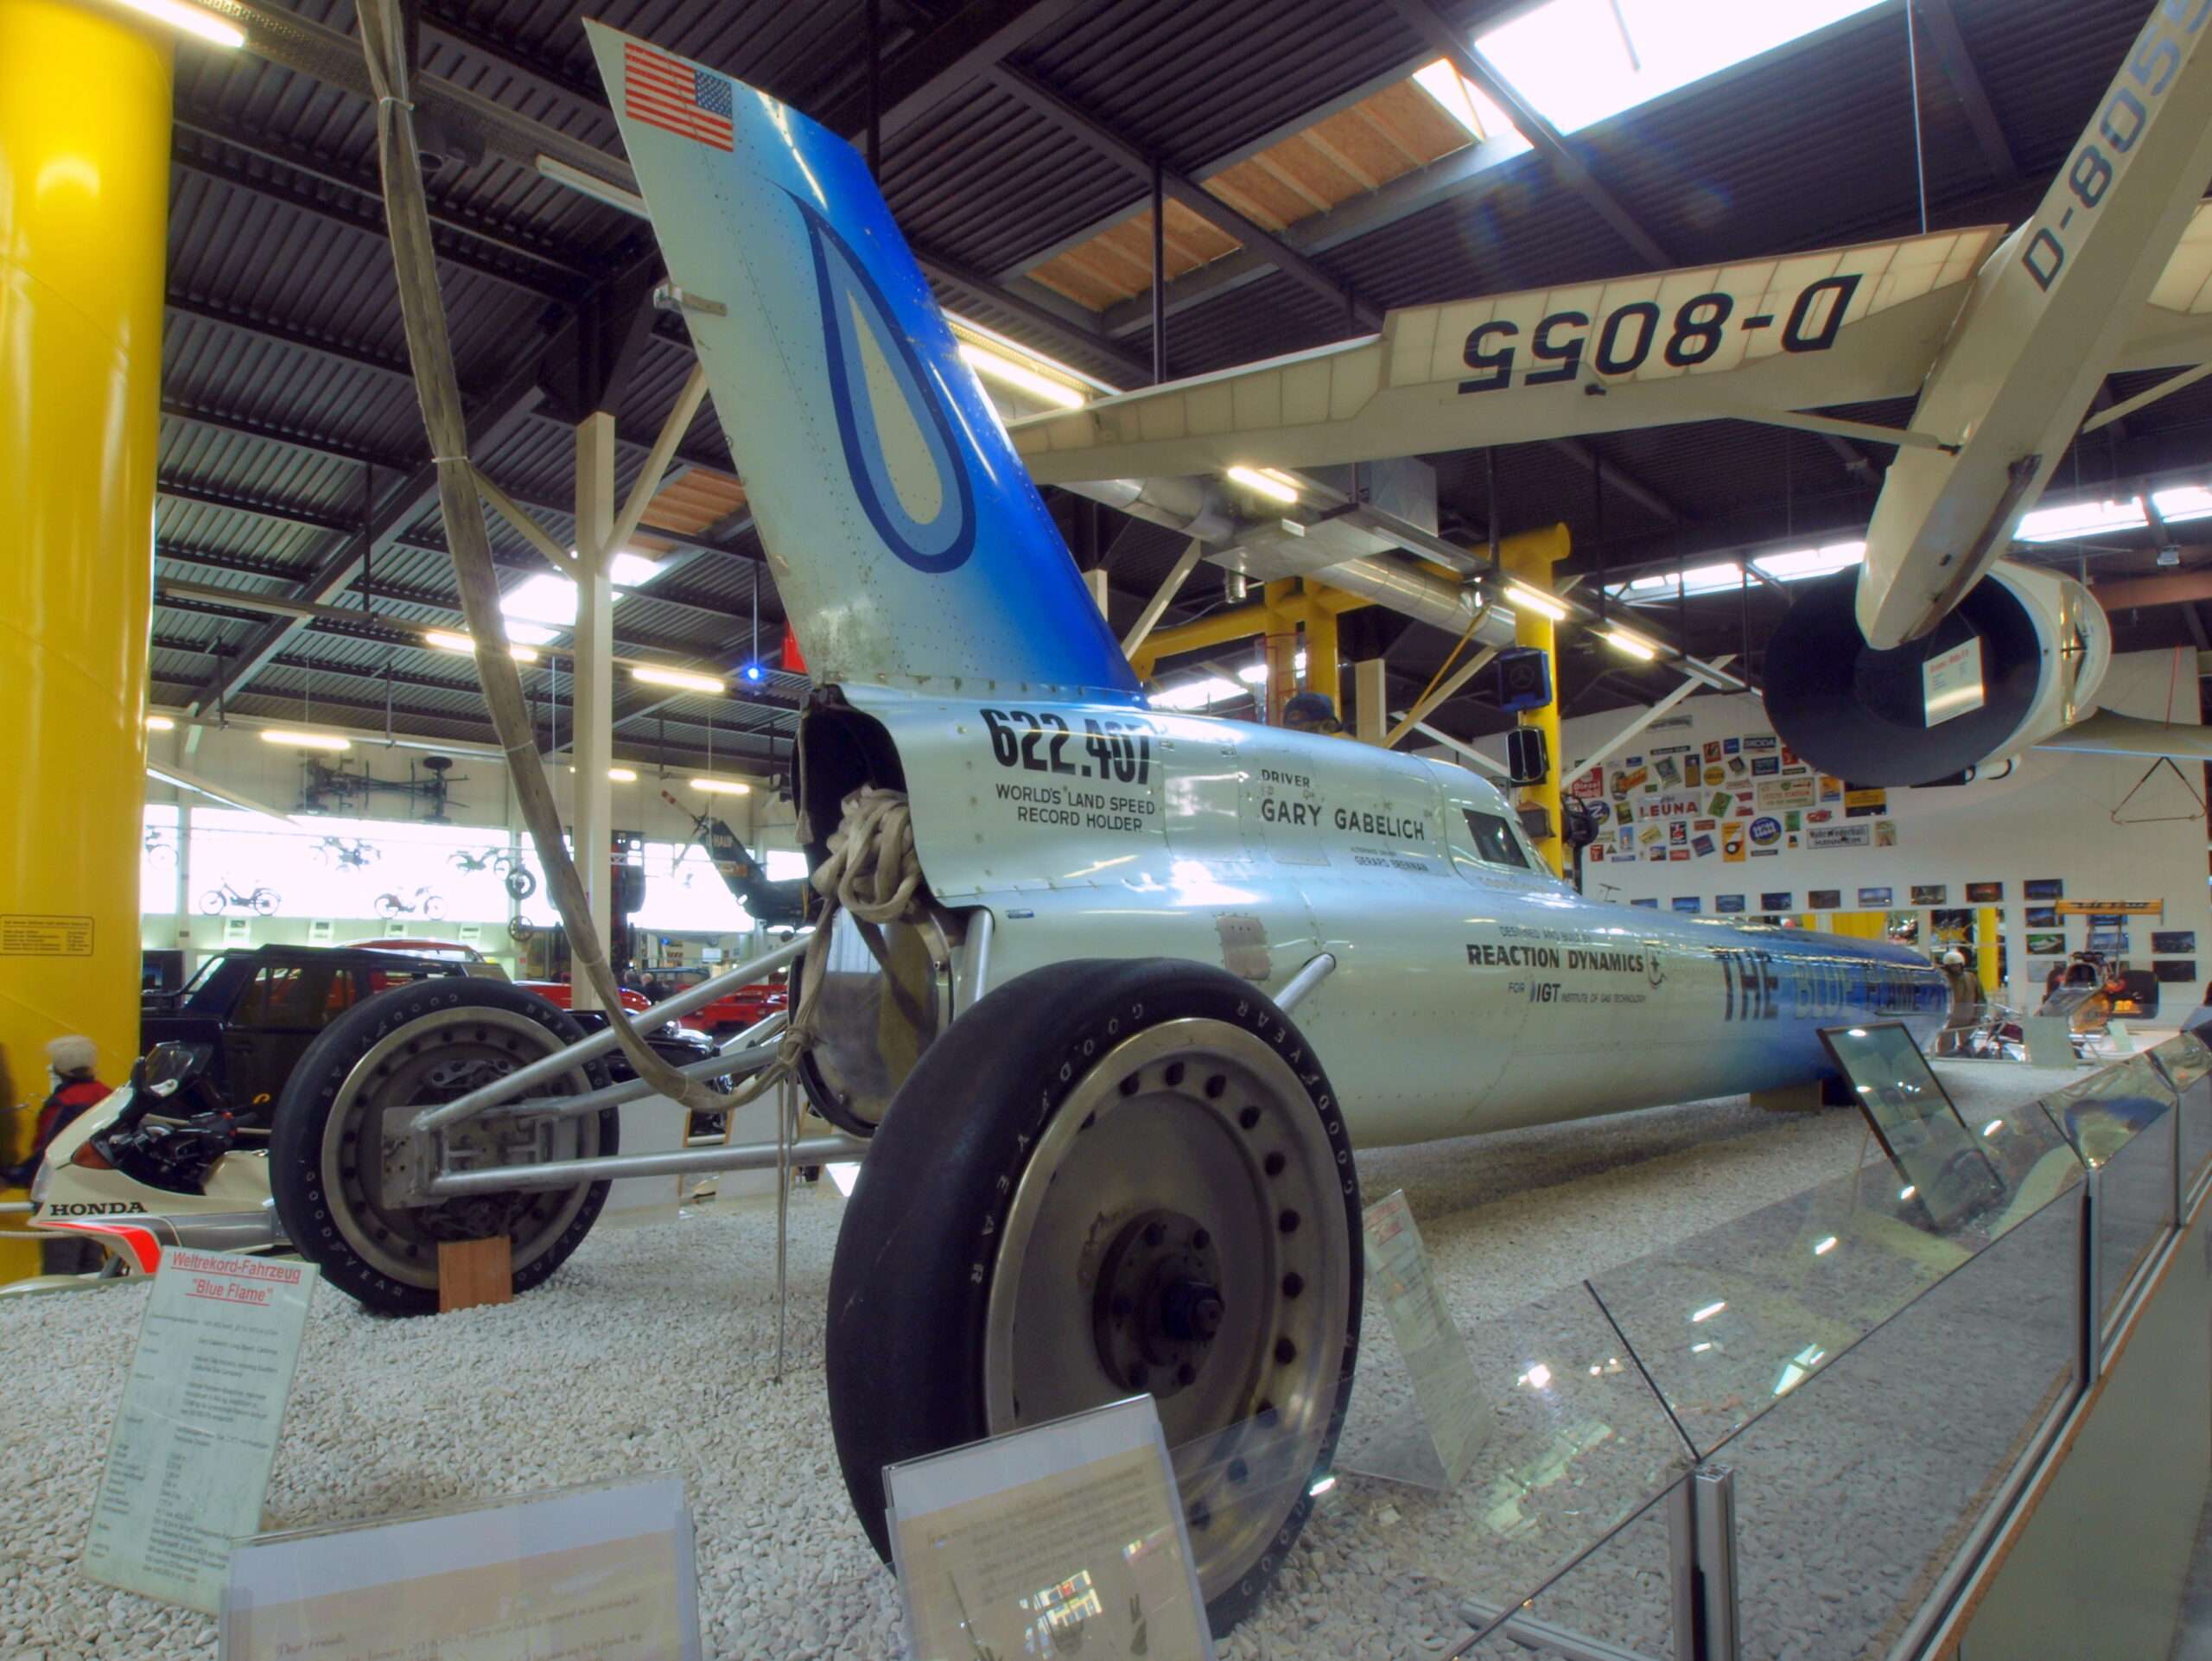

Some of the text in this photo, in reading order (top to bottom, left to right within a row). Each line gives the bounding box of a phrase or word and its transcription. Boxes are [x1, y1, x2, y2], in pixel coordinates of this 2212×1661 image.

[1458, 273, 1863, 395] D-8055
[981, 709, 1151, 785] 622.407
[1262, 769, 1310, 788] DRIVER
[996, 783, 1155, 815] WORLD'S LAND SPEED
[1638, 801, 1699, 818] LEUNA
[1018, 806, 1142, 831] RECORD HOLDER
[1262, 798, 1425, 841] GARY GABELICH
[1466, 944, 1645, 973] REACTION DYNAMICS
[1508, 982, 1526, 995] FOR
[1536, 982, 1562, 1003] IGT
[1713, 949, 1779, 1021] THE
[1794, 963, 1854, 1021] BLUE
[50, 1201, 148, 1216] HONDA
[172, 1251, 302, 1282] Weltrekord-Fahrzeug
[193, 1277, 274, 1301] "Blue Flame"
